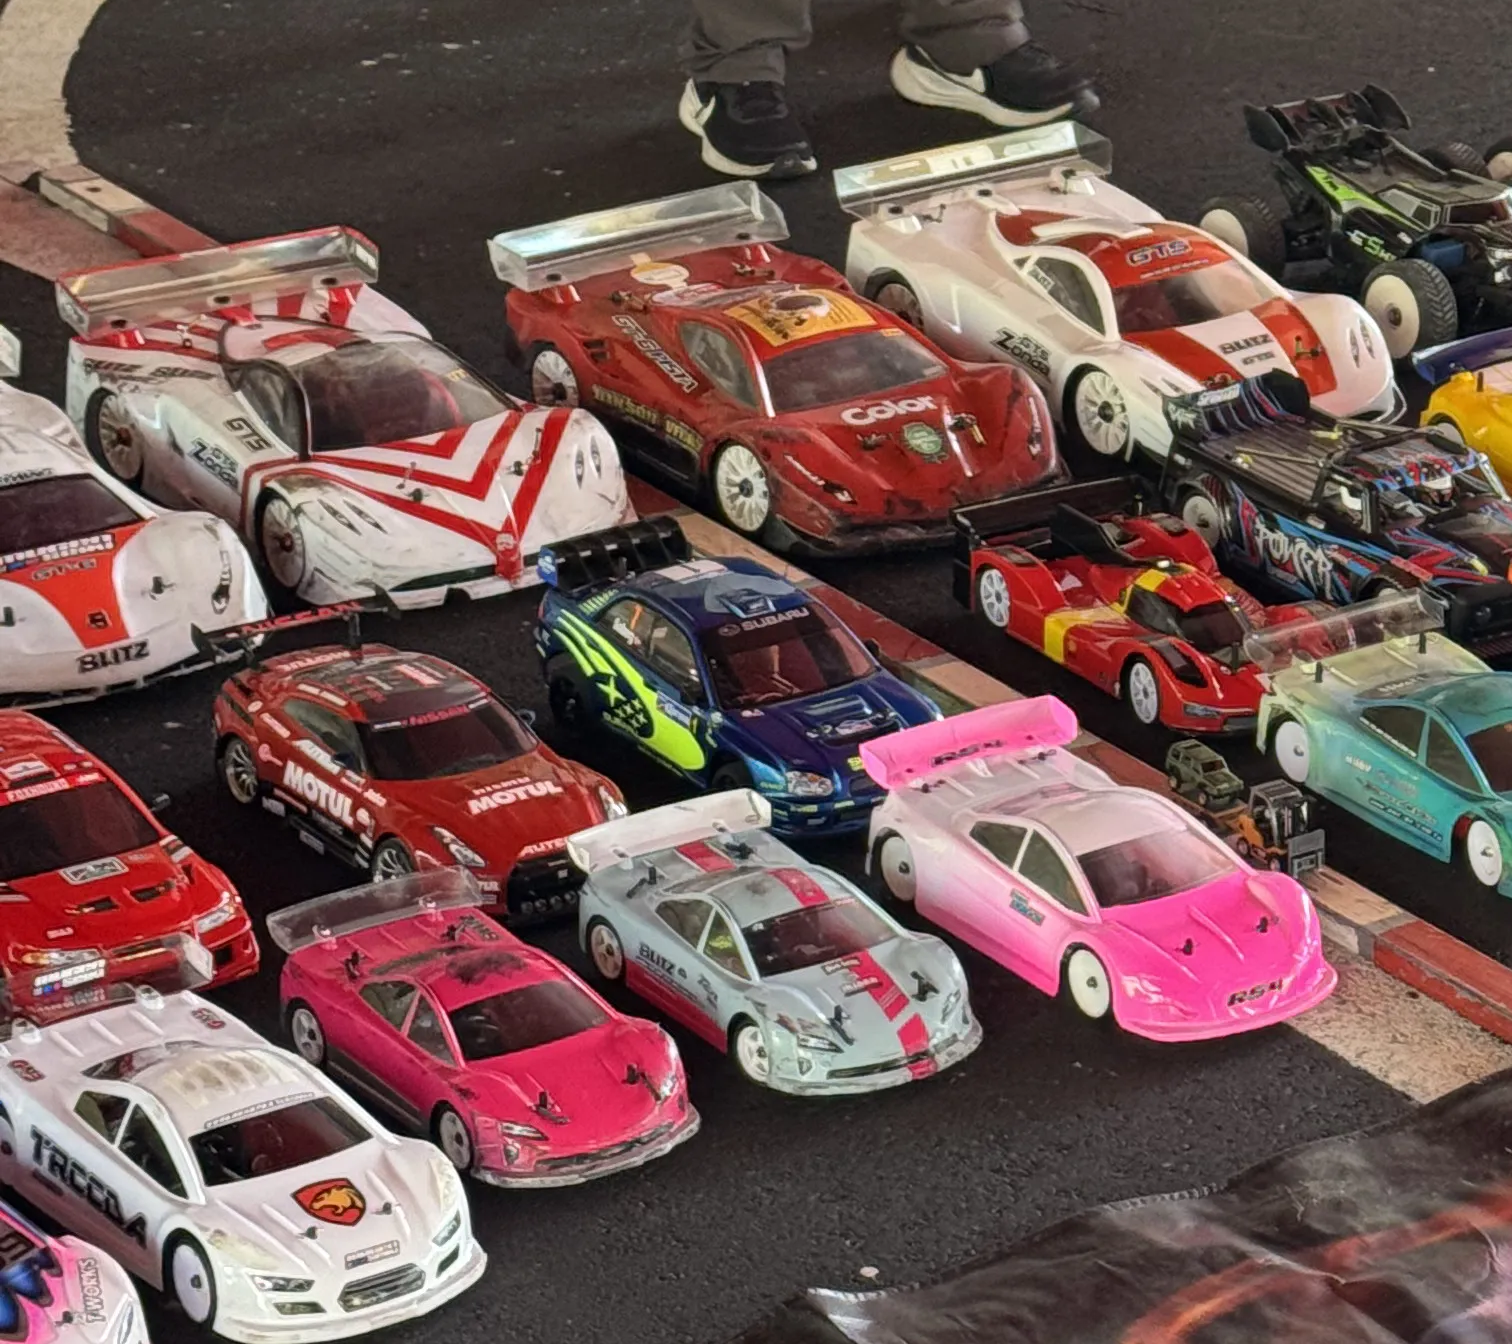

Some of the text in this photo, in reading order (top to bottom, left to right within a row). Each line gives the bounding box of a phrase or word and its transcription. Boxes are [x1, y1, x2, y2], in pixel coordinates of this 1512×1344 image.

[841, 394, 937, 426] Color
[225, 416, 271, 454] GTS
[741, 607, 809, 632] SUBARU
[77, 639, 150, 675] BLITZ
[283, 760, 355, 826] MOTUL
[467, 780, 565, 816] MOTUL
[639, 942, 676, 977] BLITZ
[1227, 978, 1284, 1007] RS4
[29, 1125, 148, 1252] TRCCDA
